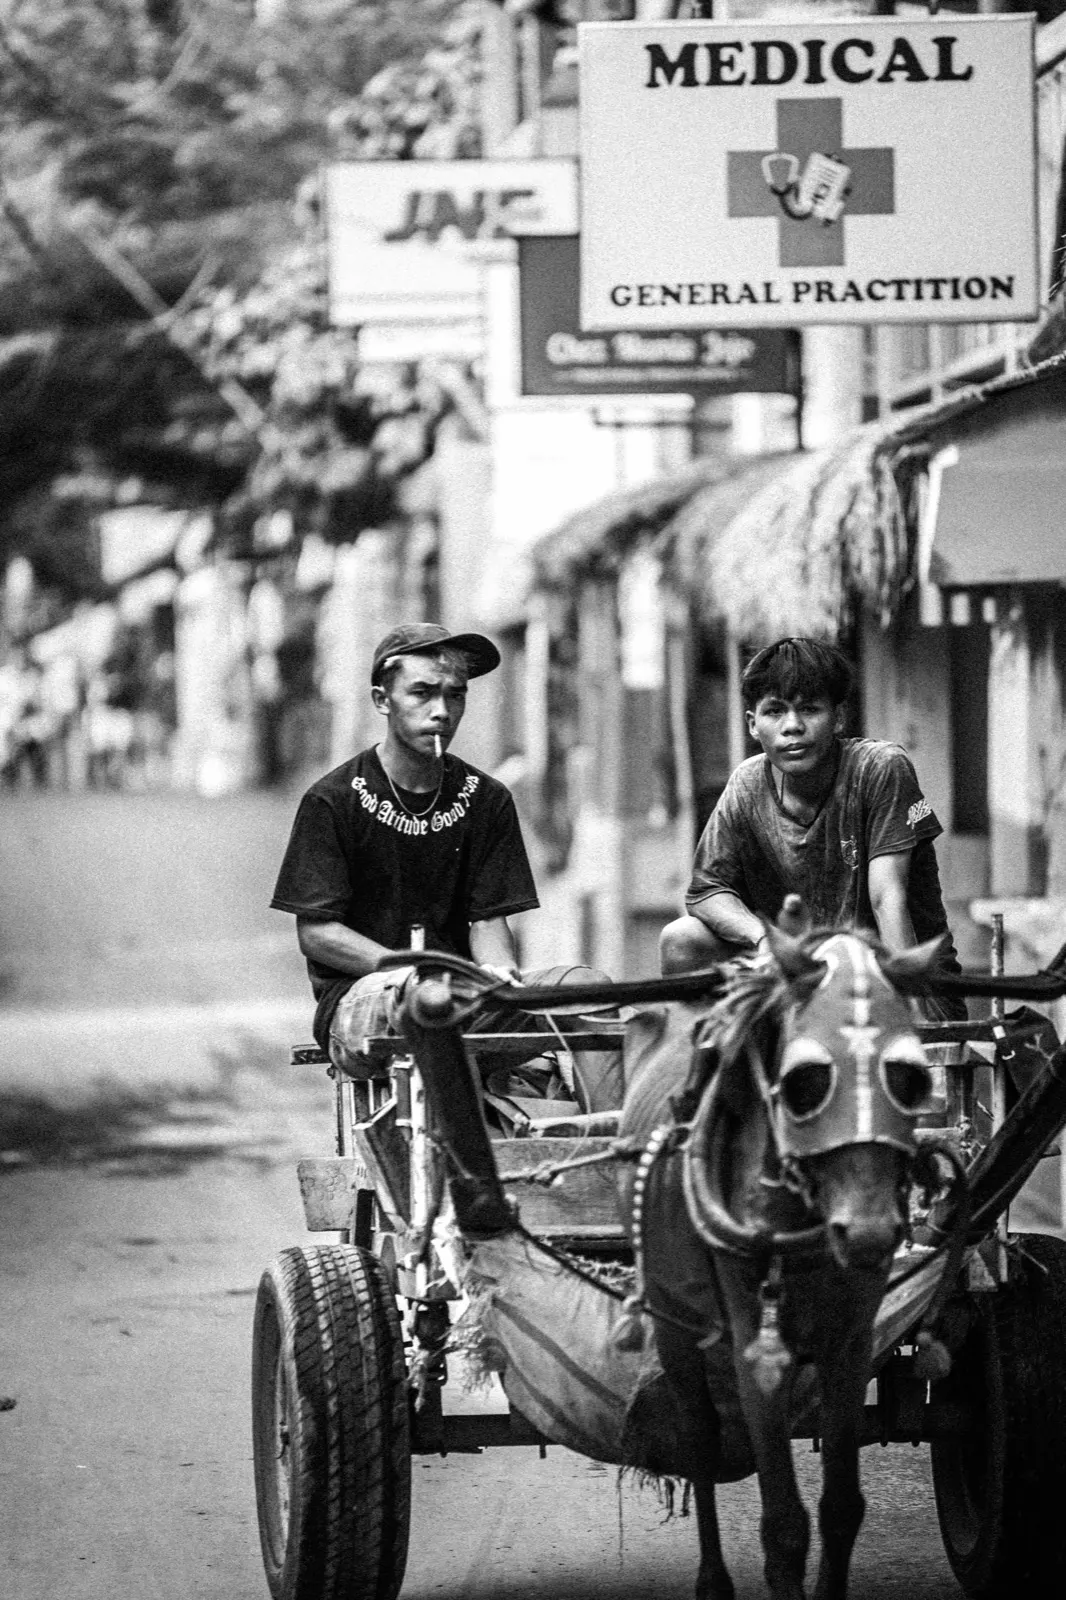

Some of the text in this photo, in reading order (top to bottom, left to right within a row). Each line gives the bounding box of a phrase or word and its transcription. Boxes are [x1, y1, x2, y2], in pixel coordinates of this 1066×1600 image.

[645, 36, 974, 88] MEDICAL
[610, 275, 1015, 307] GENERAL PRACTITION
[431, 802, 466, 832] Good
